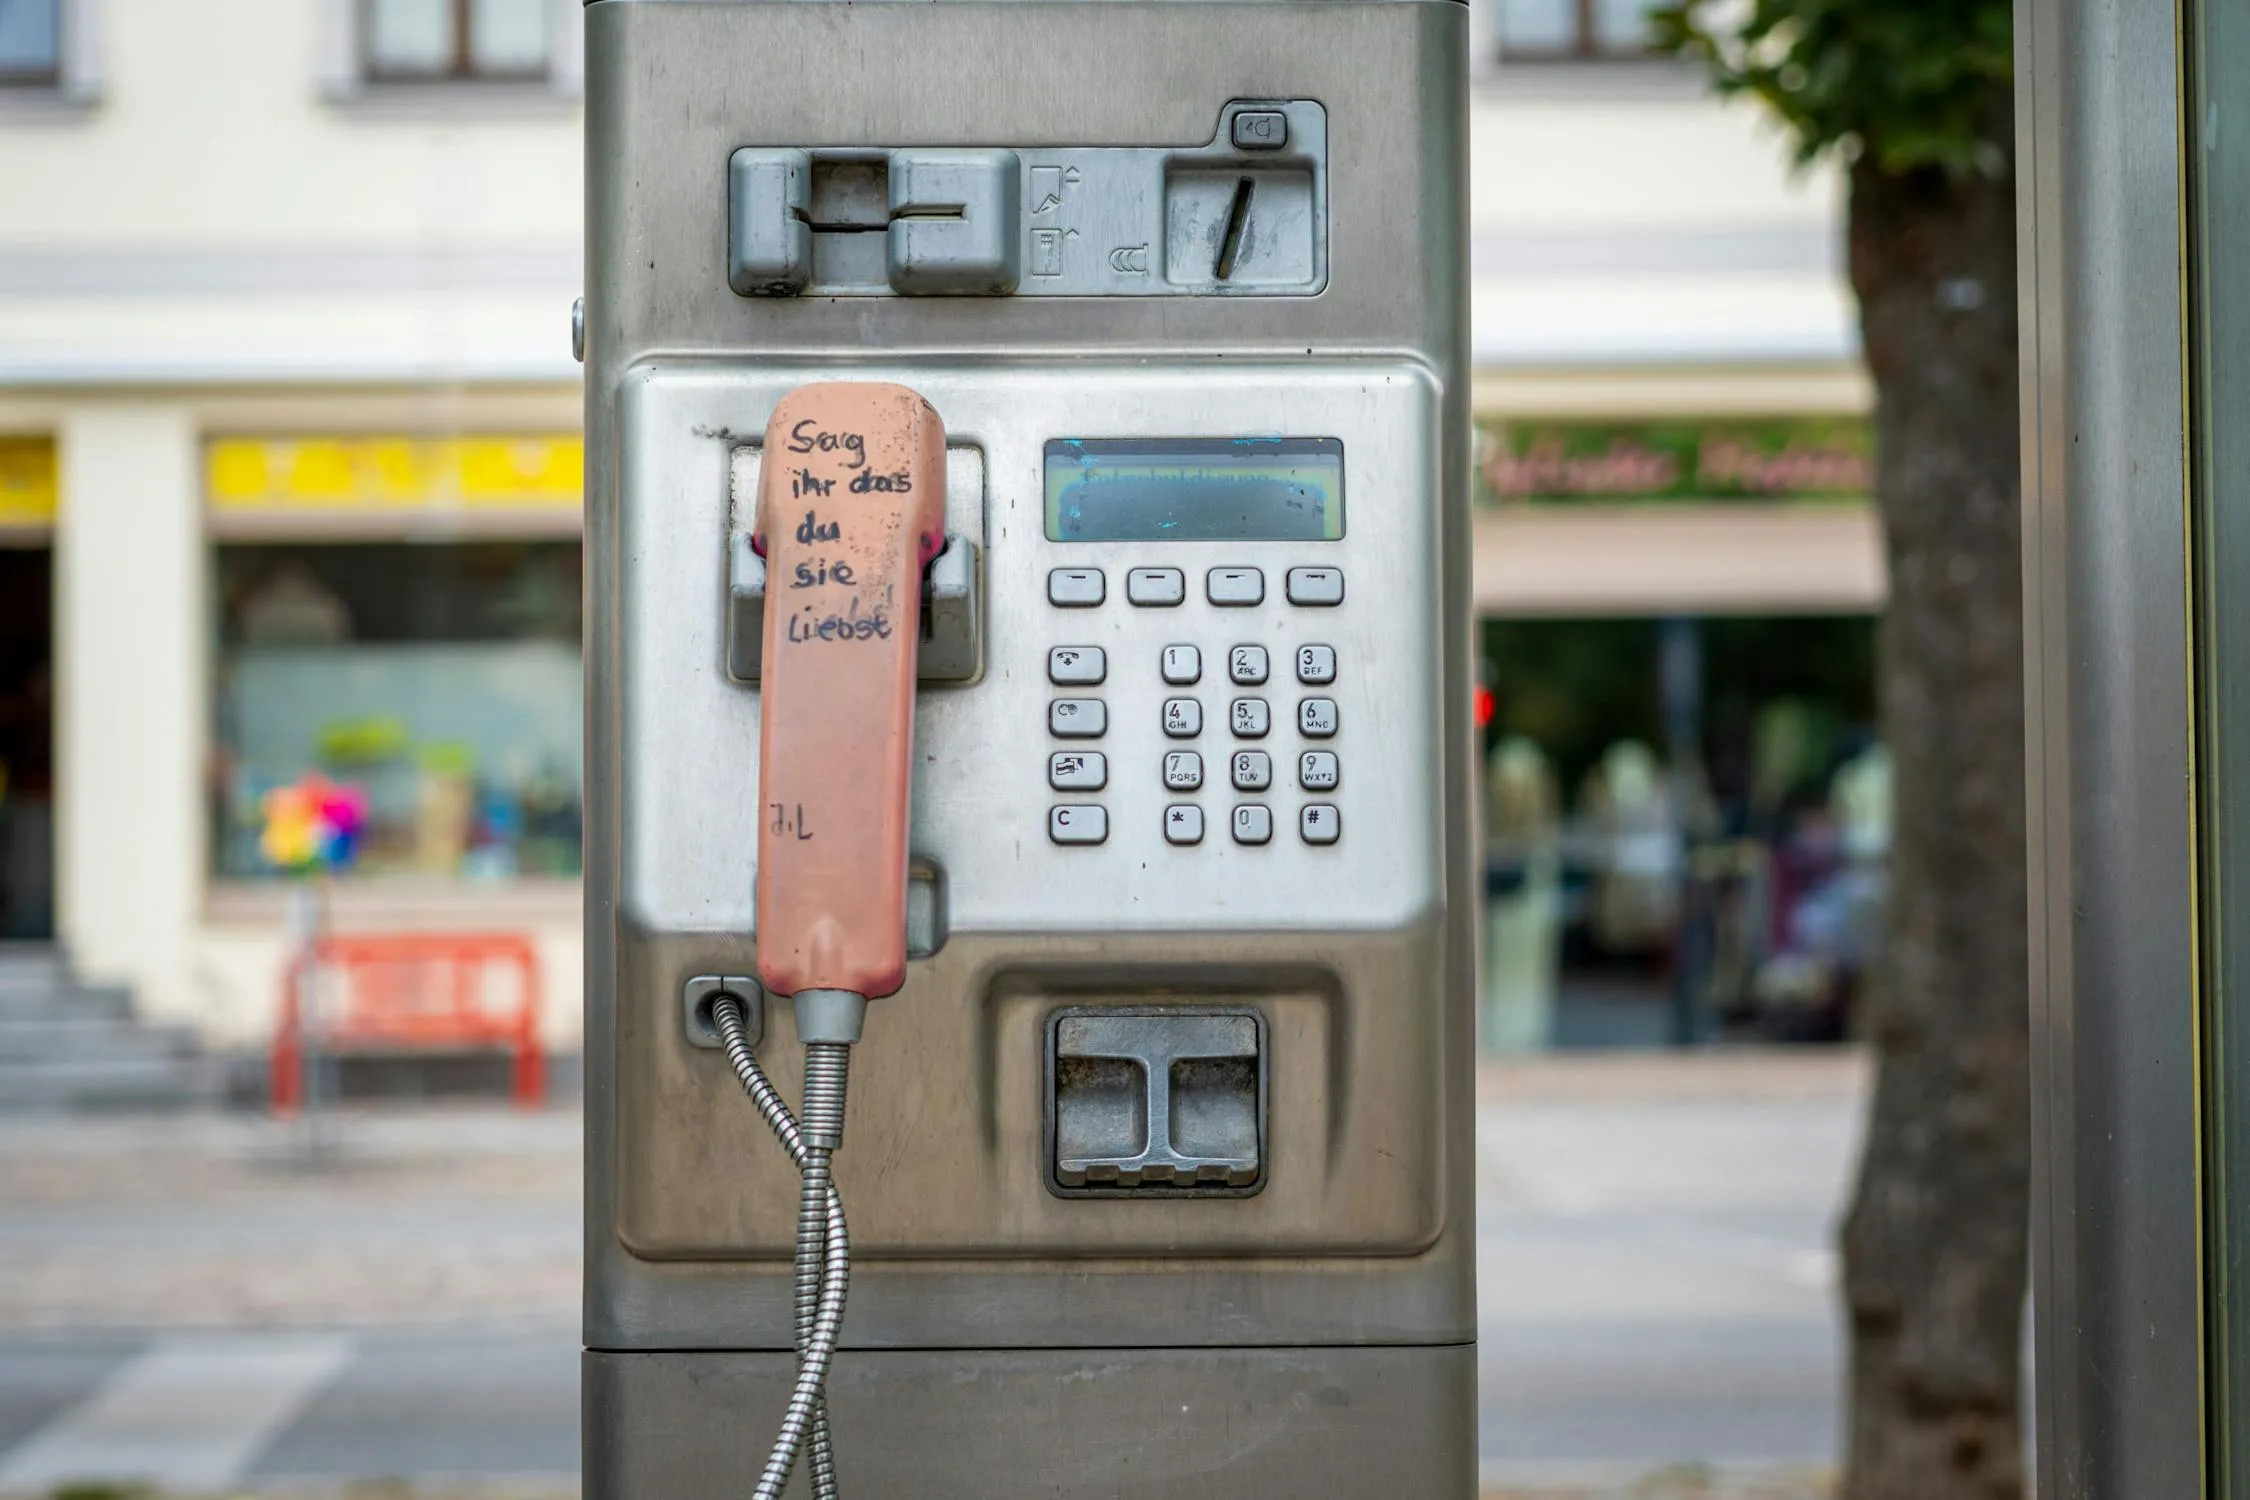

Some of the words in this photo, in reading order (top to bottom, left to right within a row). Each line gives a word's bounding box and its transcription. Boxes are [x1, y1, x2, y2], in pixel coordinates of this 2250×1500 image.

[787, 419, 866, 469] Sag
[792, 467, 837, 499] ihr
[848, 466, 913, 494] das
[796, 510, 841, 545] du
[789, 559, 857, 589] sie
[1168, 649, 1176, 665] 1
[1236, 649, 1248, 666] 2
[1303, 649, 1314, 666] 3
[1169, 702, 1181, 719] 4
[1237, 702, 1248, 719] 5
[1306, 702, 1316, 719] 6
[1168, 720, 1188, 729] GHI
[1238, 720, 1257, 729] JKL
[1170, 755, 1181, 772] 7
[1239, 755, 1250, 771] 8
[1306, 755, 1317, 771] 9
[1170, 773, 1197, 782] PQRS
[1239, 773, 1259, 782] TUV
[1304, 773, 1333, 782] WXYZ
[1057, 810, 1070, 826] C
[1239, 809, 1250, 825] 0
